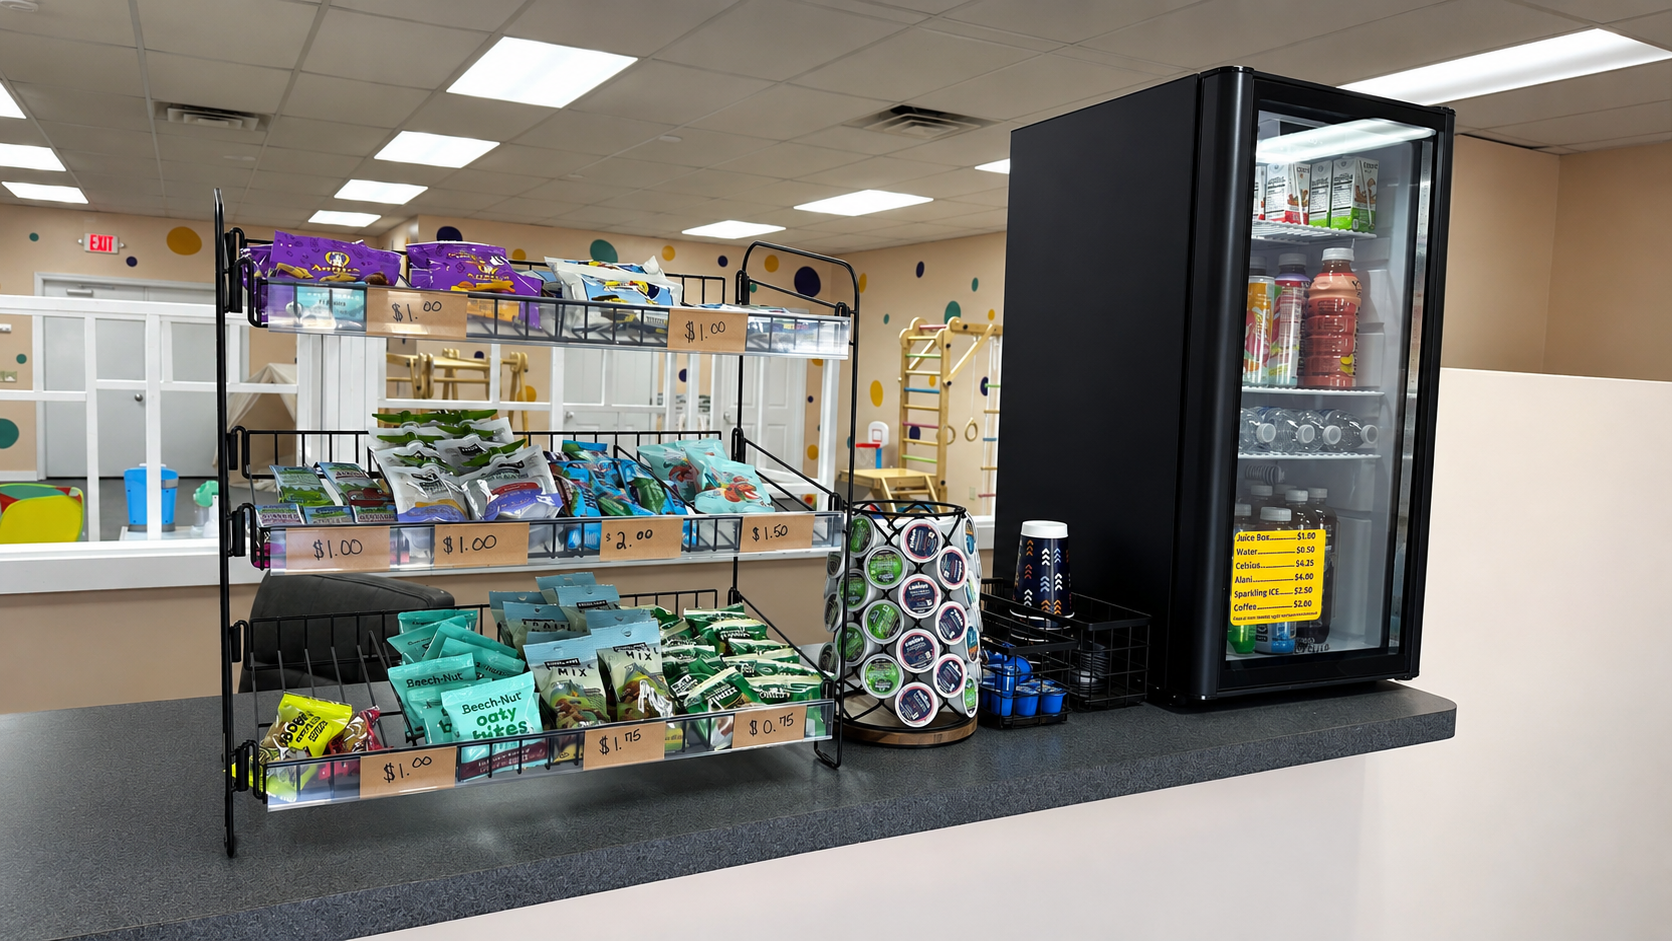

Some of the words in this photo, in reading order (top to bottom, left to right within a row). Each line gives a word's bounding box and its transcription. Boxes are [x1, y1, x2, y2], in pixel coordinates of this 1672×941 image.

[90, 234, 114, 252] EXIT
[391, 300, 442, 323] $1.00
[684, 320, 727, 344] $1.00
[605, 528, 653, 550] $2.00
[752, 523, 789, 543] $1.50
[1236, 533, 1255, 542] Juice
[312, 538, 363, 561] $1.00
[442, 534, 498, 555] $1.00
[1236, 548, 1258, 556] Water
[1296, 546, 1316, 554] $0.50
[1295, 559, 1315, 568] $4.25
[1235, 576, 1253, 584] Alani
[1295, 573, 1314, 581] $4.00
[1234, 589, 1267, 599] Sparkling
[1269, 588, 1280, 596] ICE
[1294, 586, 1313, 595] $2.50
[1233, 603, 1257, 612] Coffee
[1293, 600, 1312, 608] $2.00
[558, 668, 587, 677] MIX
[462, 692, 522, 715] Beech-Nut
[476, 707, 517, 727] oaty
[749, 712, 795, 737] $0.75
[599, 728, 642, 756] $1.75
[383, 756, 433, 783] $1.00
